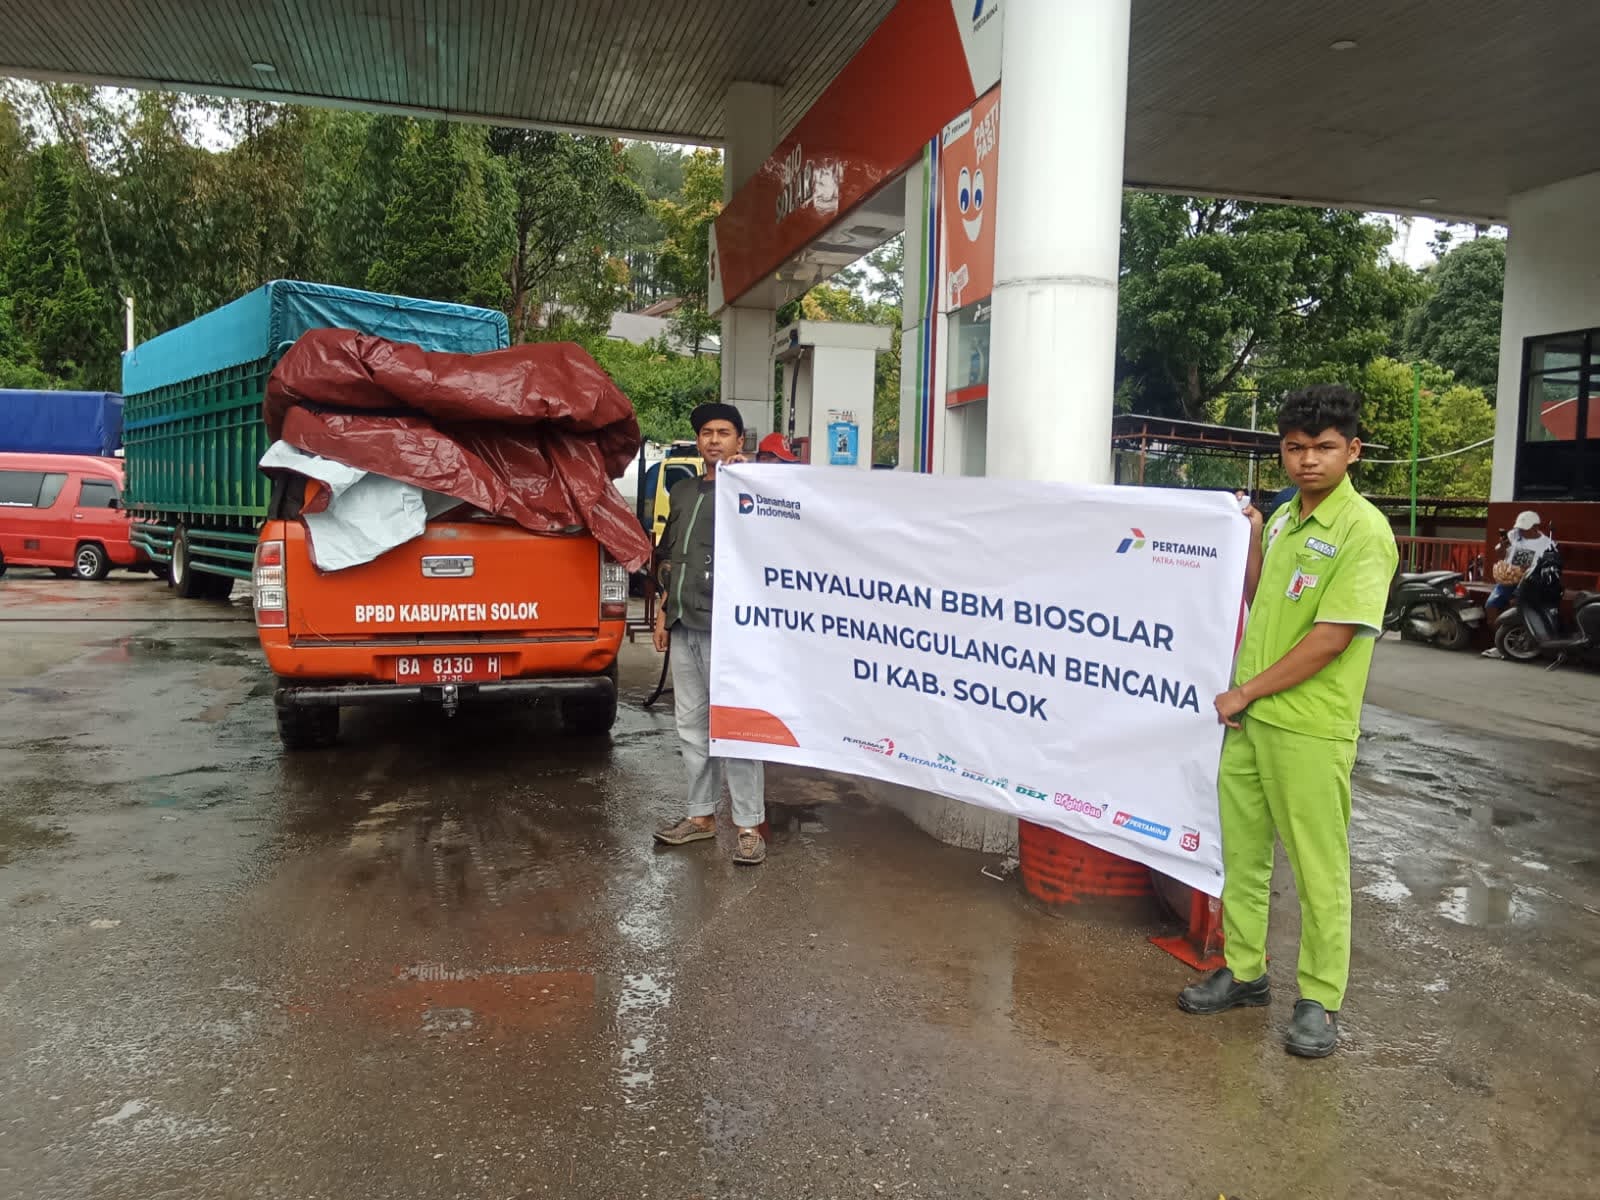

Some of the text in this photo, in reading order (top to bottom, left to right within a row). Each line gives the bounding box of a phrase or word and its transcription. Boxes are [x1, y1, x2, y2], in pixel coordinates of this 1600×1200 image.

[756, 494, 801, 510] Danantara
[757, 505, 801, 520] Indonesia
[1152, 540, 1218, 558] PERTAMINA
[1152, 556, 1175, 566] PATRA
[355, 602, 539, 622] BPBD KABUPATEN SOLOK
[764, 567, 1174, 651] PENYALURAN BBM BIOSOLAR
[398, 657, 498, 675] BA 8130 H
[735, 605, 1200, 713] UNTUK PENANGGULANGAN BENCANA
[854, 658, 1048, 721] DI KAB. SOLOK
[898, 752, 957, 773] PERTAMAX
[1015, 785, 1048, 800] DEX
[1055, 793, 1102, 819] Bright Gas
